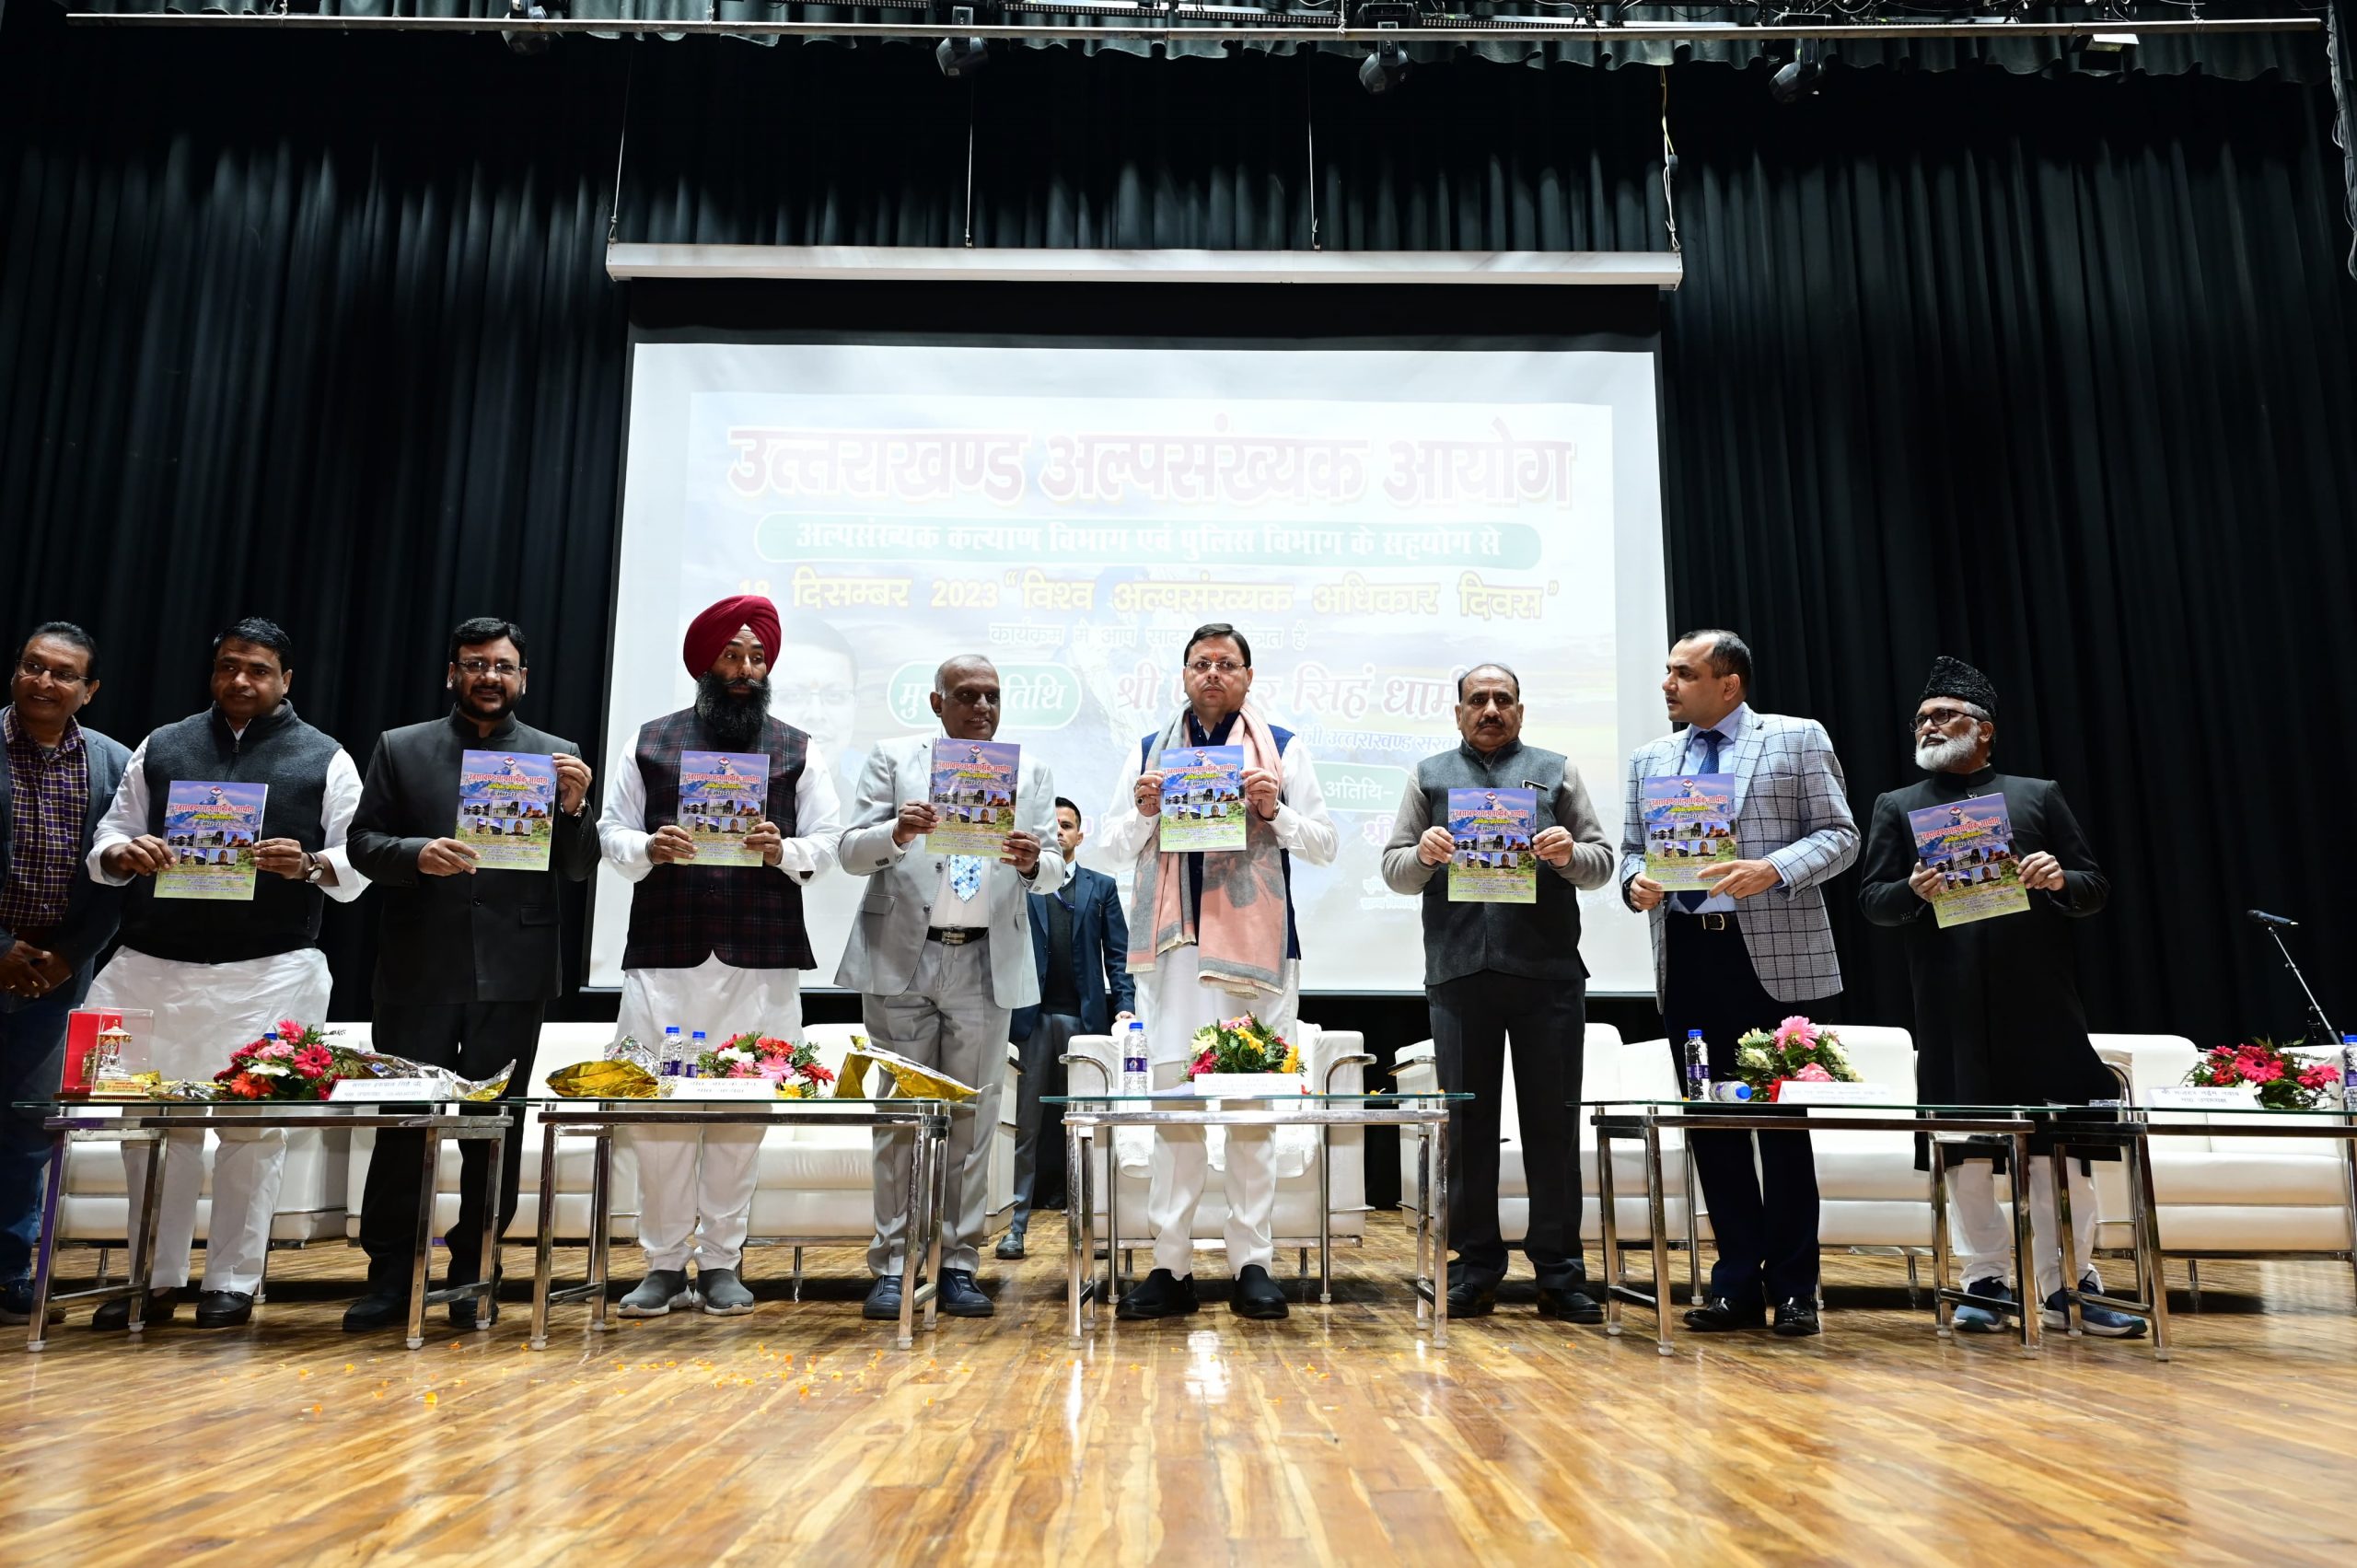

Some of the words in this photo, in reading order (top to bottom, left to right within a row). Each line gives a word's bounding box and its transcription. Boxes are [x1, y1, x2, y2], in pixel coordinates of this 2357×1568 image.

[728, 427, 1029, 505] उत्तराखण्ड
[1039, 412, 1368, 504] अल्पसंख्यक
[1383, 416, 1573, 507] आयोग
[796, 517, 939, 550] अल्पसंख्यक
[947, 525, 1041, 551] कल्याण
[1051, 521, 1128, 552] विभाग
[1136, 525, 1171, 552] एवं
[1179, 523, 1255, 562] पुलिस
[1263, 524, 1344, 556] विभाग
[1350, 525, 1376, 556] के
[1382, 526, 1472, 561] सहयोग
[1479, 526, 1503, 557] से
[792, 566, 912, 609] दिसम्बर
[930, 579, 999, 610] 2023
[1111, 570, 1295, 614] अल्पसंख्यक
[1312, 571, 1440, 615] अधिकार
[1100, 625, 1138, 646] आप
[1000, 673, 1068, 711] तिथि
[1116, 659, 1162, 712] श्री
[1327, 728, 1413, 751] उत्तराखण्ड
